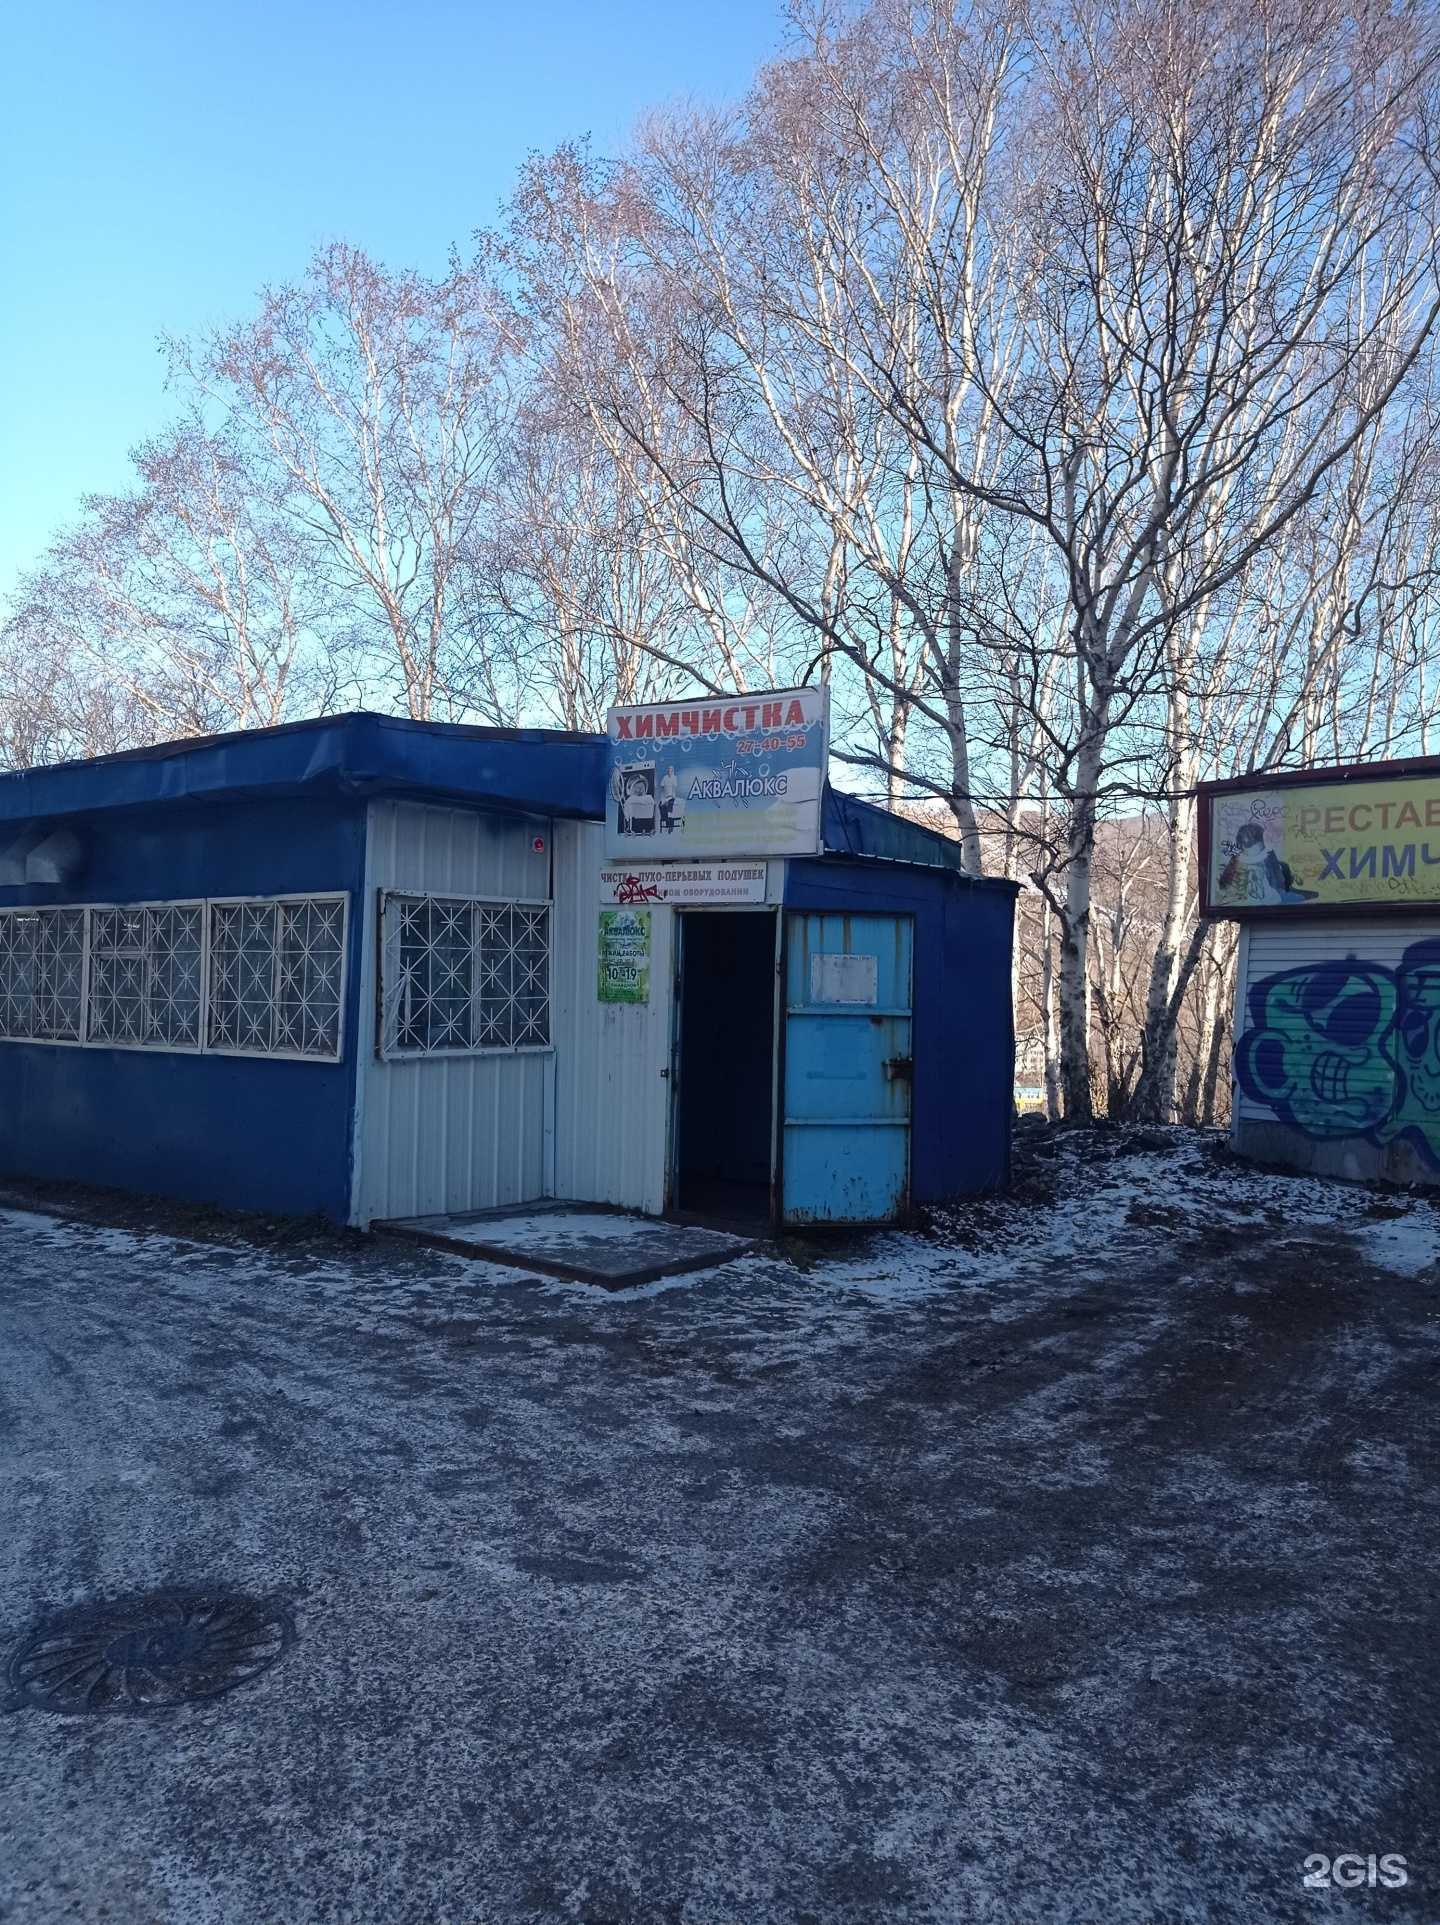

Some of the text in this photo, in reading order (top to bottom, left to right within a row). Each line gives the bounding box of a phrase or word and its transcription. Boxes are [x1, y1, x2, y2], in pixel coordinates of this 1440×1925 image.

[616, 699, 805, 740] ХИМЧИСТКА
[736, 735, 807, 754] 27-40-55
[717, 869, 764, 880] ПОДУШЕК
